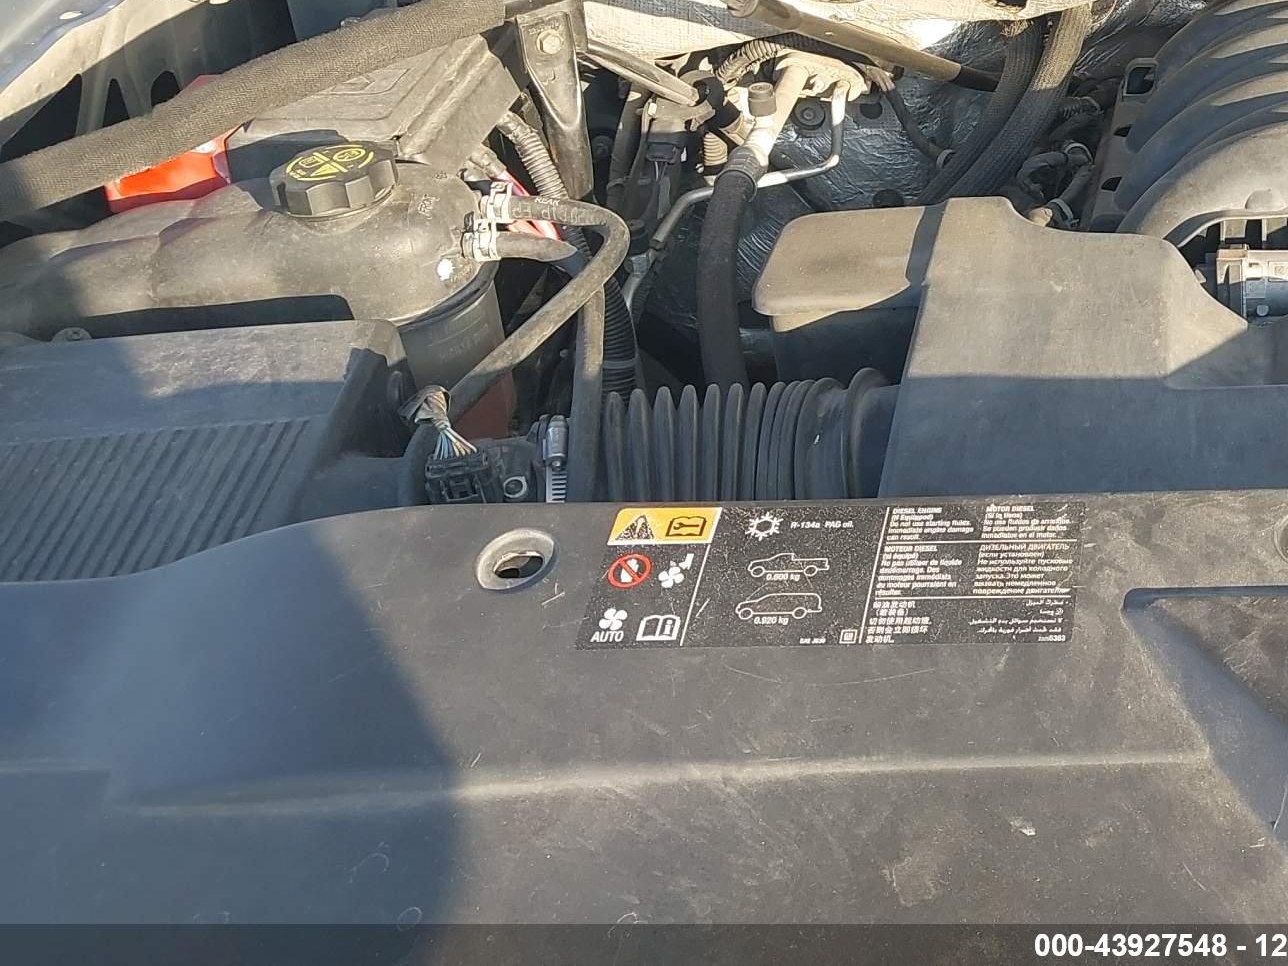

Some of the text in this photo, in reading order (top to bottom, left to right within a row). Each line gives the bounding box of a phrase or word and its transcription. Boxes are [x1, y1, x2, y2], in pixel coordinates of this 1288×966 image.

[790, 520, 854, 529] R-134a PAG oil.
[789, 573, 801, 581] kg
[753, 617, 789, 626] 0.920 kg
[590, 630, 624, 643] AUTO
